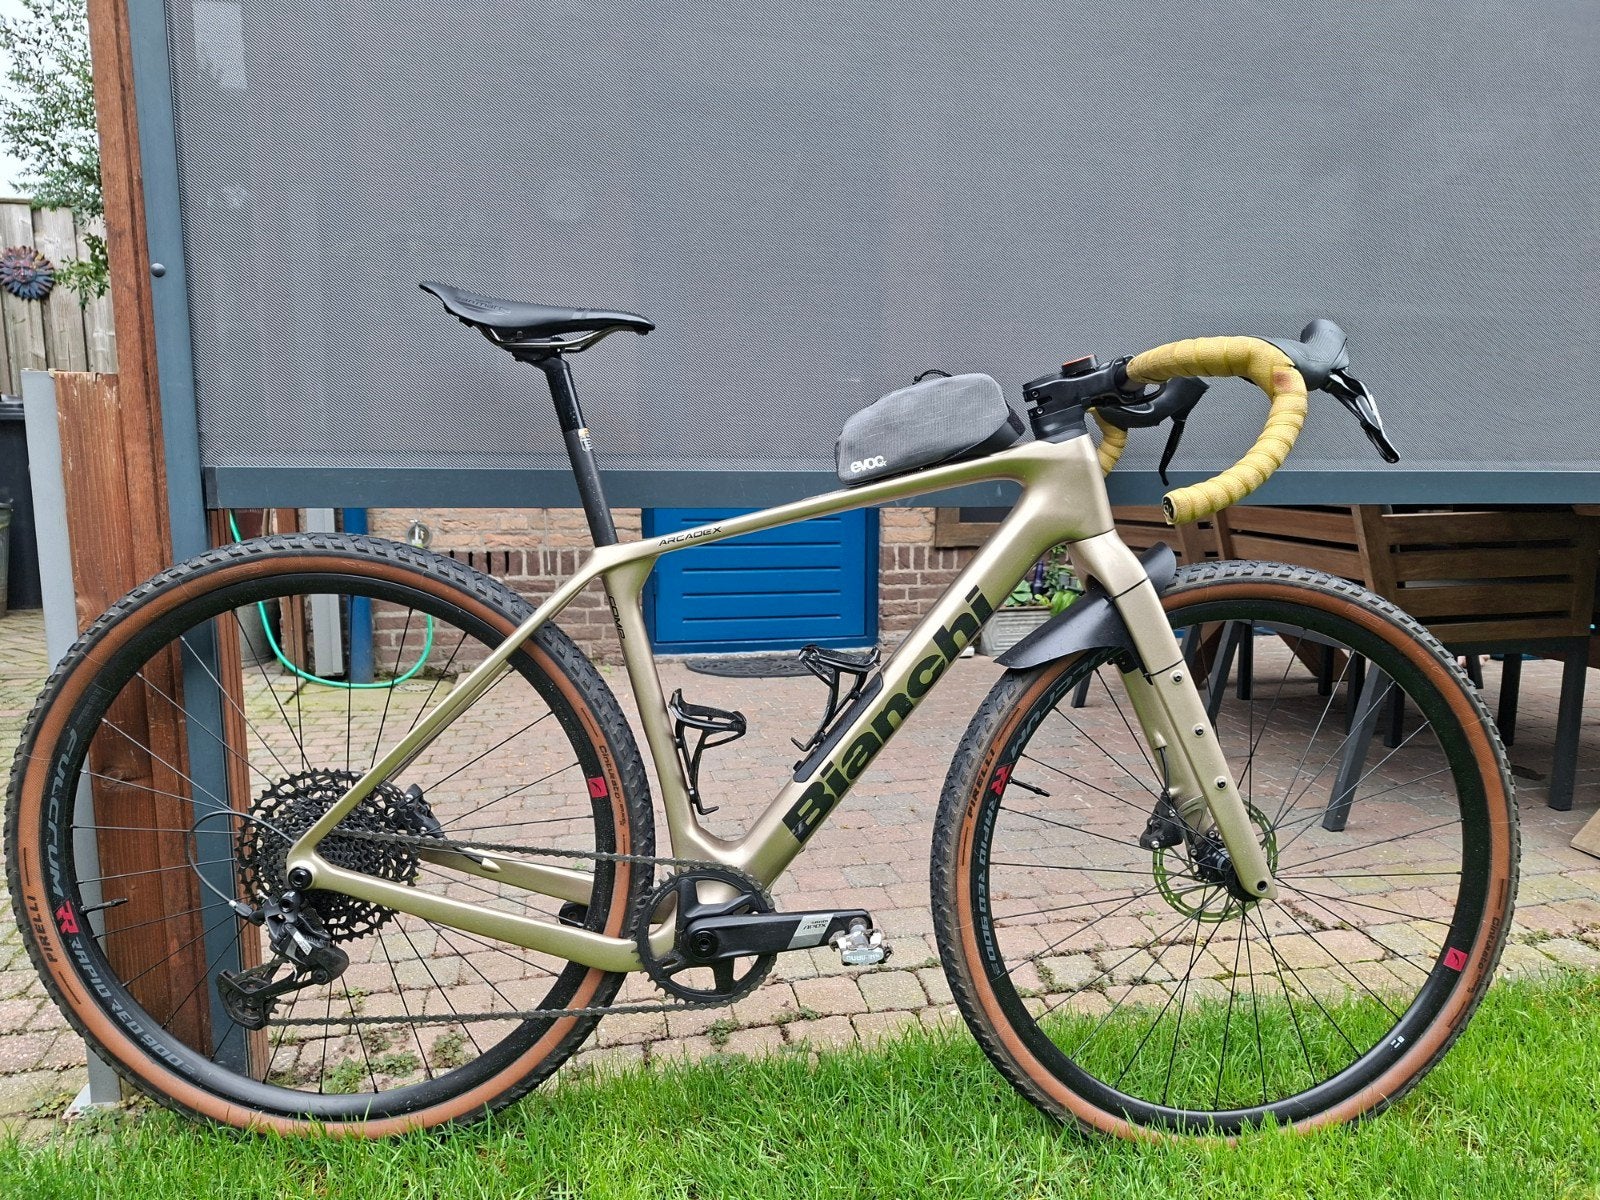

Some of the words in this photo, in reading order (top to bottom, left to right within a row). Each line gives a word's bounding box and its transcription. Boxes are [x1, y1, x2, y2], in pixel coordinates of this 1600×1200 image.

[609, 595, 625, 639] COMP
[782, 585, 993, 844] Bianchi
[599, 745, 620, 799] Cinturato
[967, 748, 995, 818] PIRELLI
[46, 728, 77, 897] FULCRUM
[979, 798, 998, 866] RAPID
[978, 870, 986, 912] RED
[27, 896, 58, 963] PIRELLI
[980, 916, 996, 961] 900
[71, 938, 110, 998] RAPID
[109, 998, 144, 1033] RED
[141, 1033, 183, 1067] 900
